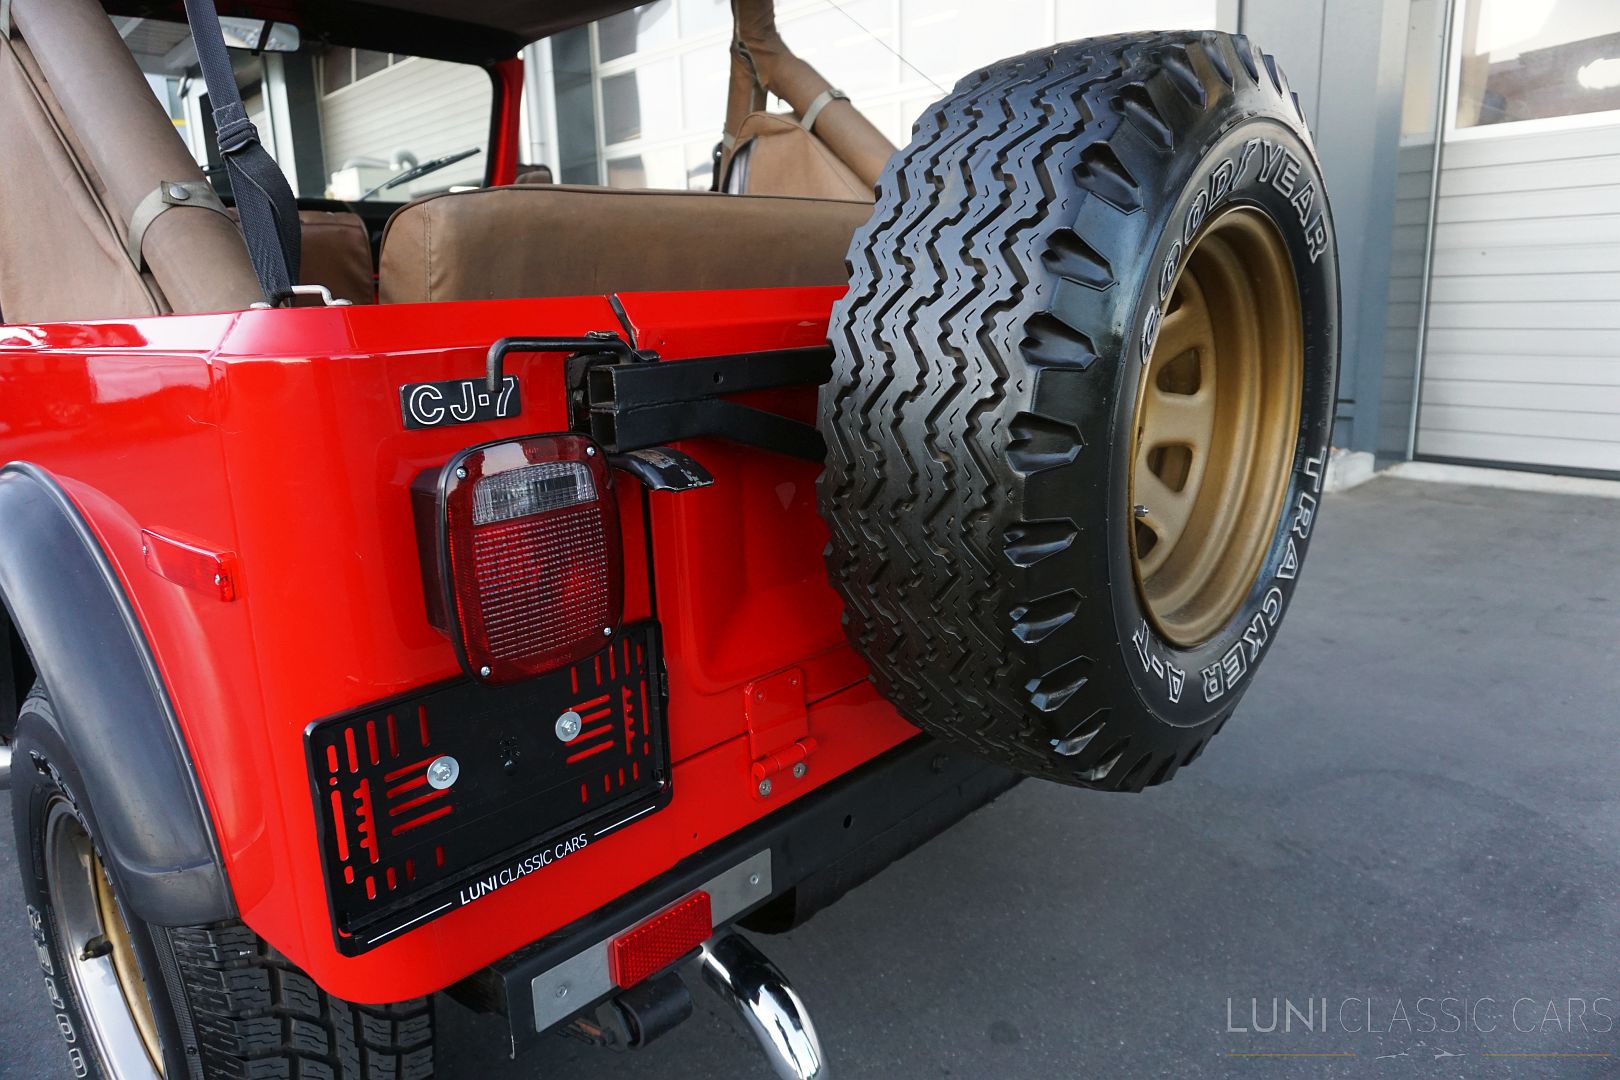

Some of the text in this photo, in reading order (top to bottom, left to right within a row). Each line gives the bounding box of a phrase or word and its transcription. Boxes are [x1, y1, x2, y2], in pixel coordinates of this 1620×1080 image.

[1141, 138, 1328, 364] GOODYEAR
[1199, 446, 1327, 703] TRACKER
[460, 833, 588, 905] LUNI CLASSIC CARS
[27, 904, 86, 1078] OOPER
